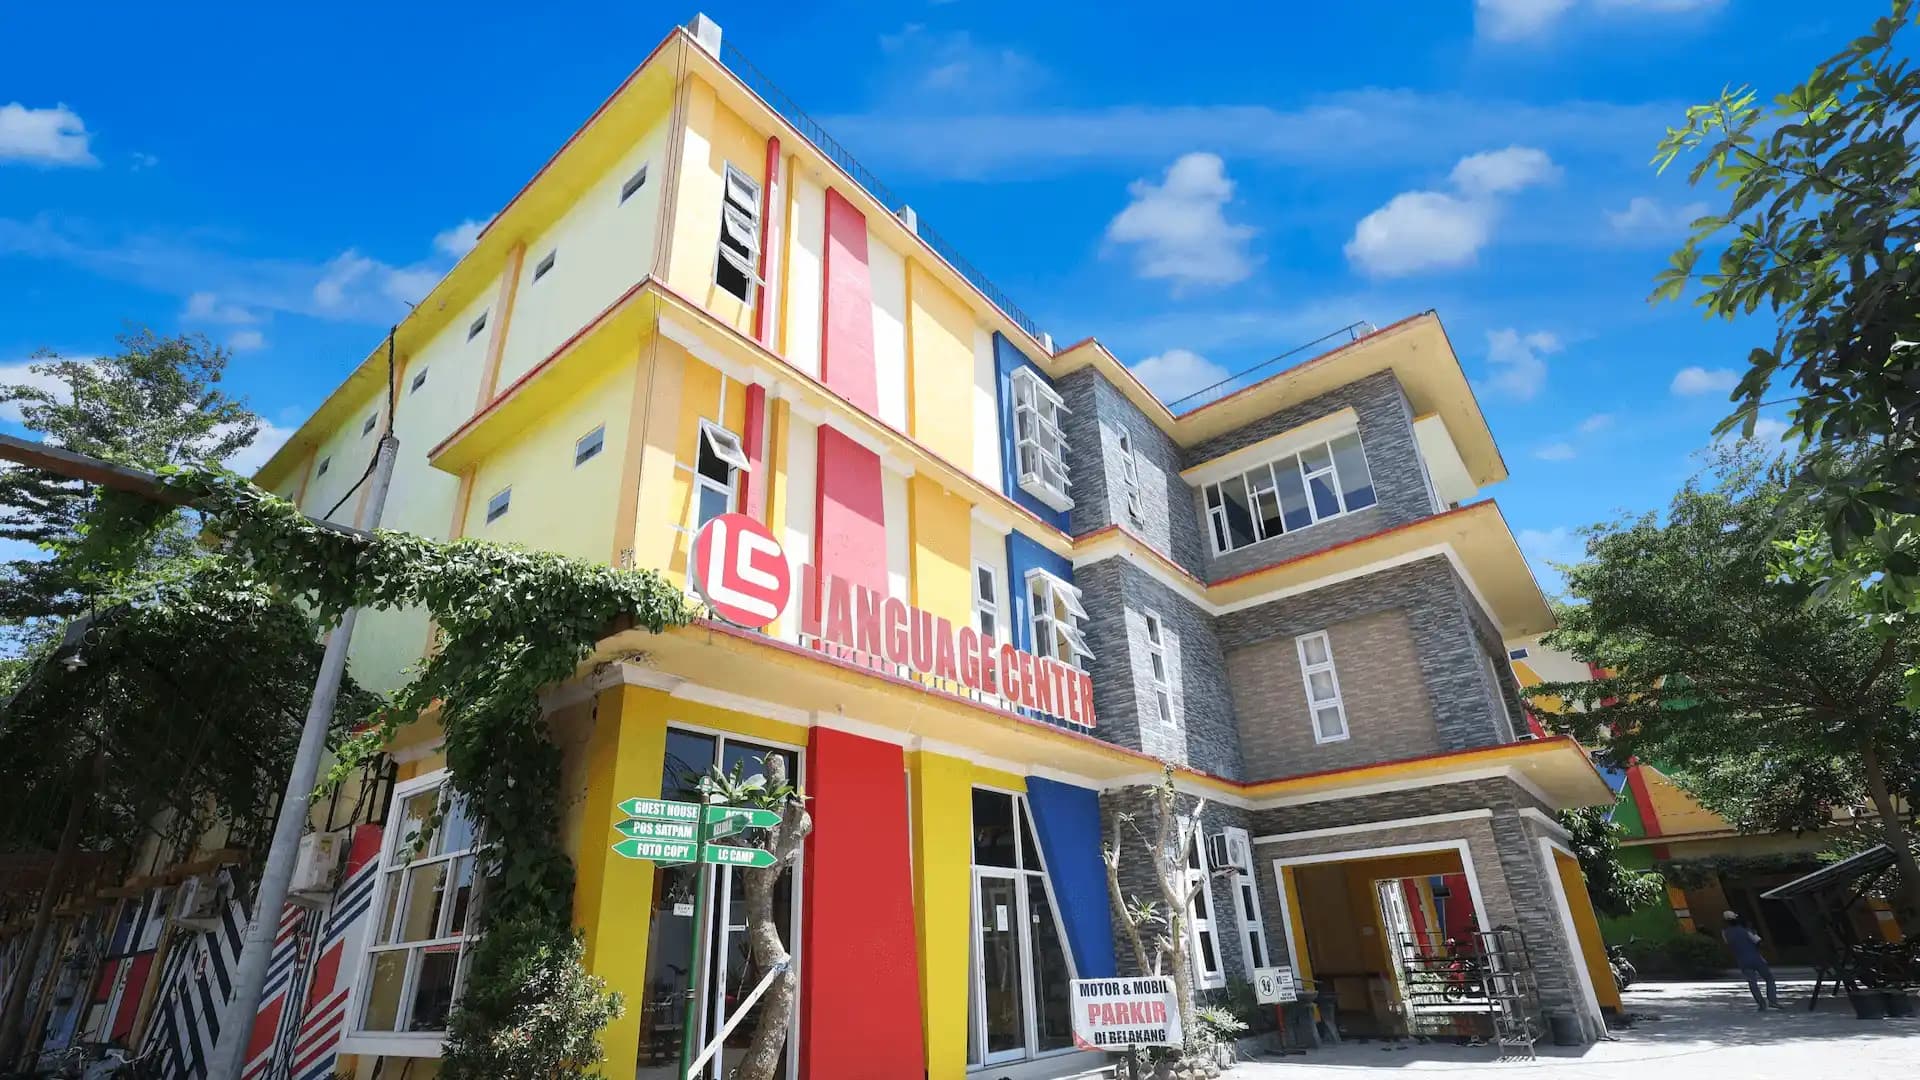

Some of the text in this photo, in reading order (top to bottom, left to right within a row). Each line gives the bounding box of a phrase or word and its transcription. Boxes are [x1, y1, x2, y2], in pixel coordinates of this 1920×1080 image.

[800, 563, 1098, 728] LANGUAGE CENTER
[635, 801, 698, 818] GUEST HOUSE
[633, 821, 693, 839] POS SATPAM
[637, 843, 689, 858] FOTO COPY
[718, 849, 754, 864] LC CAMP
[1080, 980, 1169, 997] MOTOR & MOBIL
[1088, 1001, 1167, 1026] PARKIR
[1094, 1029, 1166, 1045] DI BELAKANG
